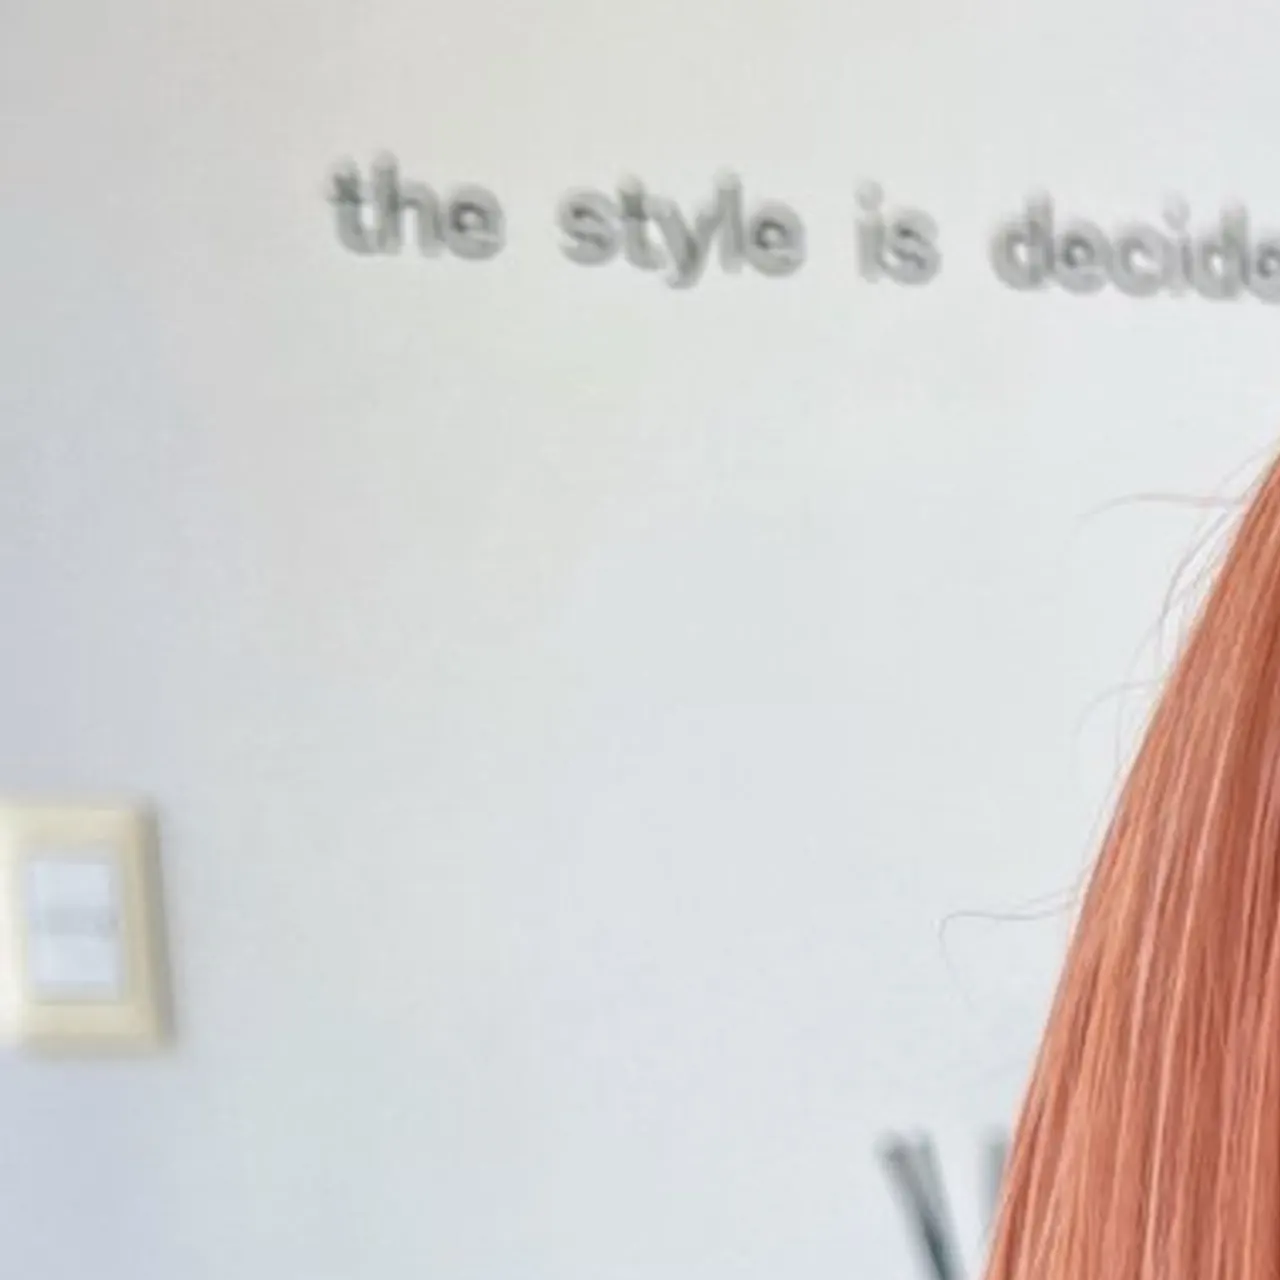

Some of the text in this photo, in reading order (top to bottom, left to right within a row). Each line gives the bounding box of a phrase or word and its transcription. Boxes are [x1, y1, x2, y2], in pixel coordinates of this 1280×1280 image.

[332, 151, 506, 262] the
[557, 166, 808, 290] style
[854, 179, 942, 287] is
